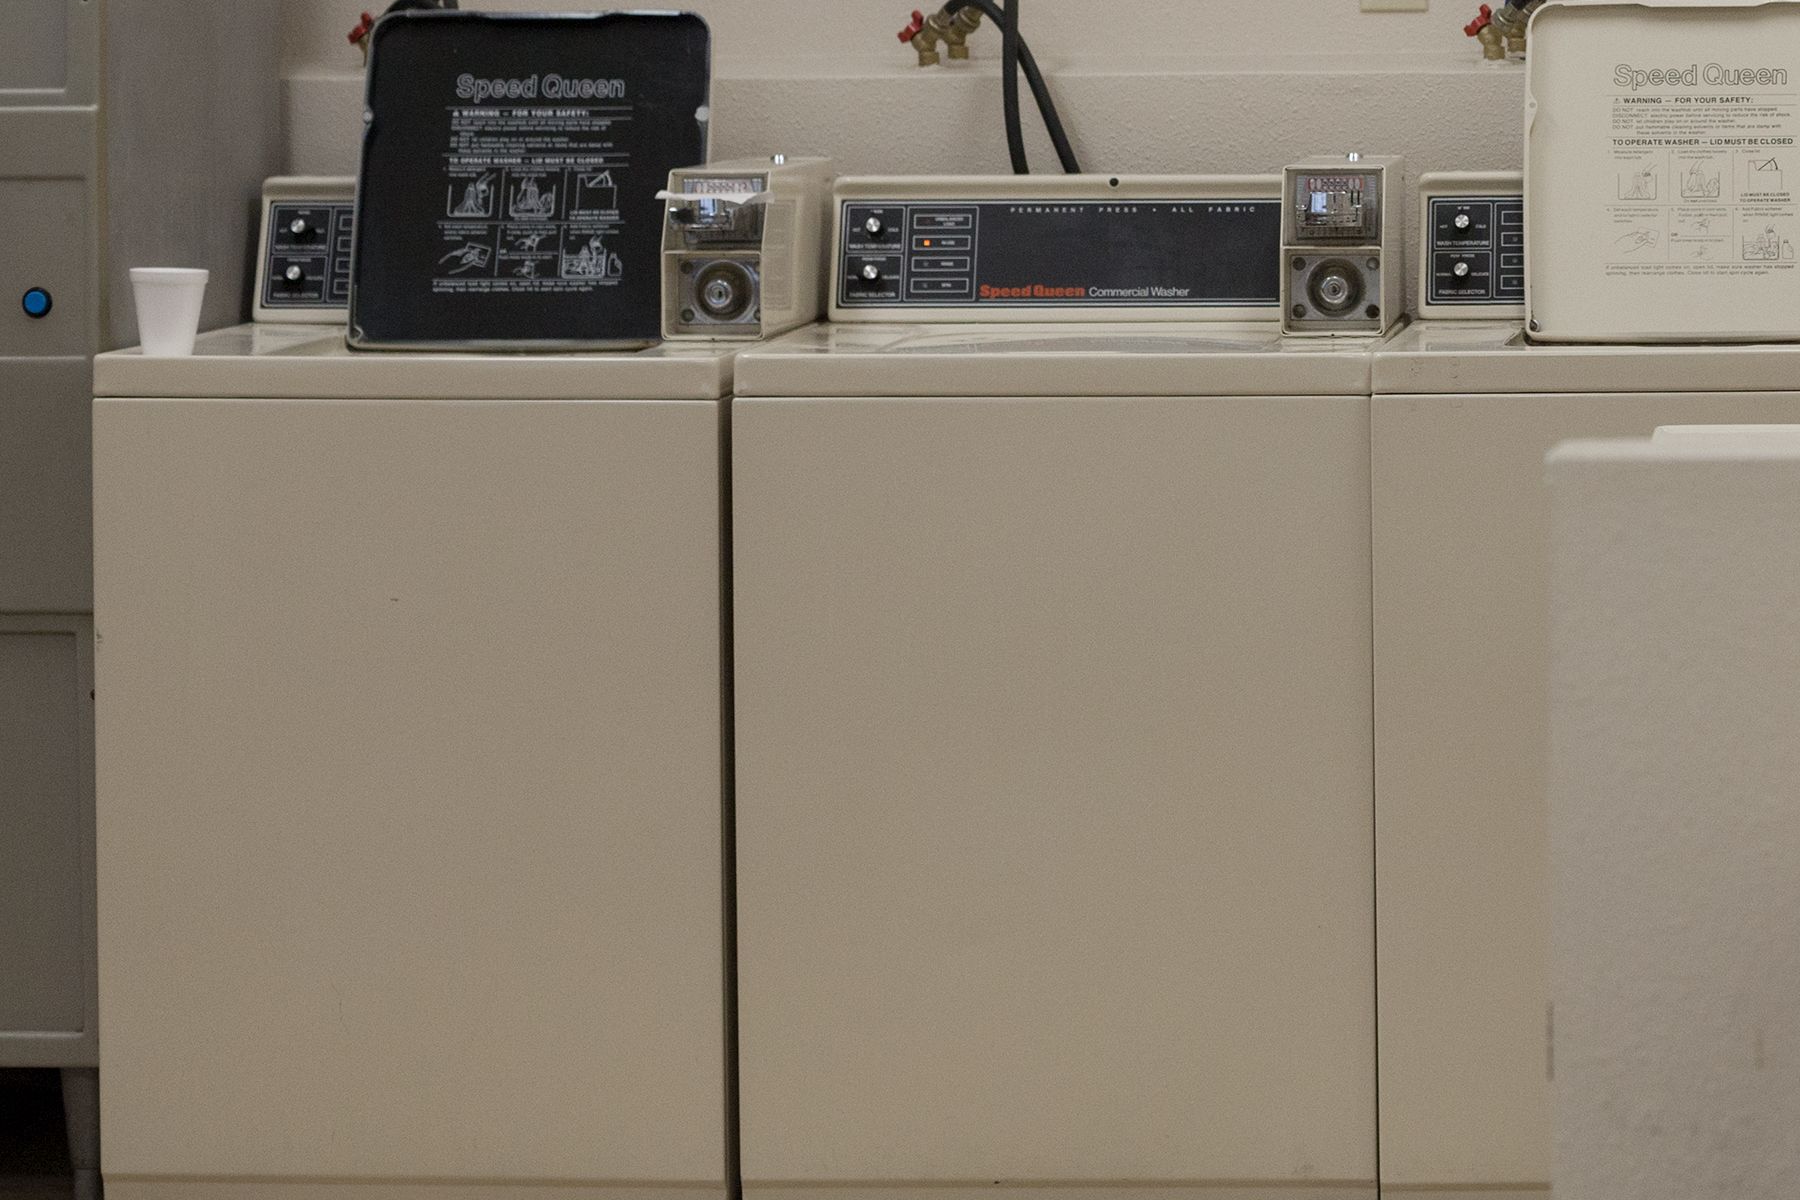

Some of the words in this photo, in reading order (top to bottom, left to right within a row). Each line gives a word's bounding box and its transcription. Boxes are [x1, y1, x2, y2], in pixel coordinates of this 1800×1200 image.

[456, 73, 538, 103] Speed
[542, 73, 625, 99] Queen
[1613, 64, 1697, 91] Speed
[1703, 63, 1787, 86] Queen
[979, 284, 1031, 299] Speed
[1033, 284, 1085, 297] Queen
[1089, 286, 1148, 297] Commercial
[1150, 286, 1189, 297] Washer
